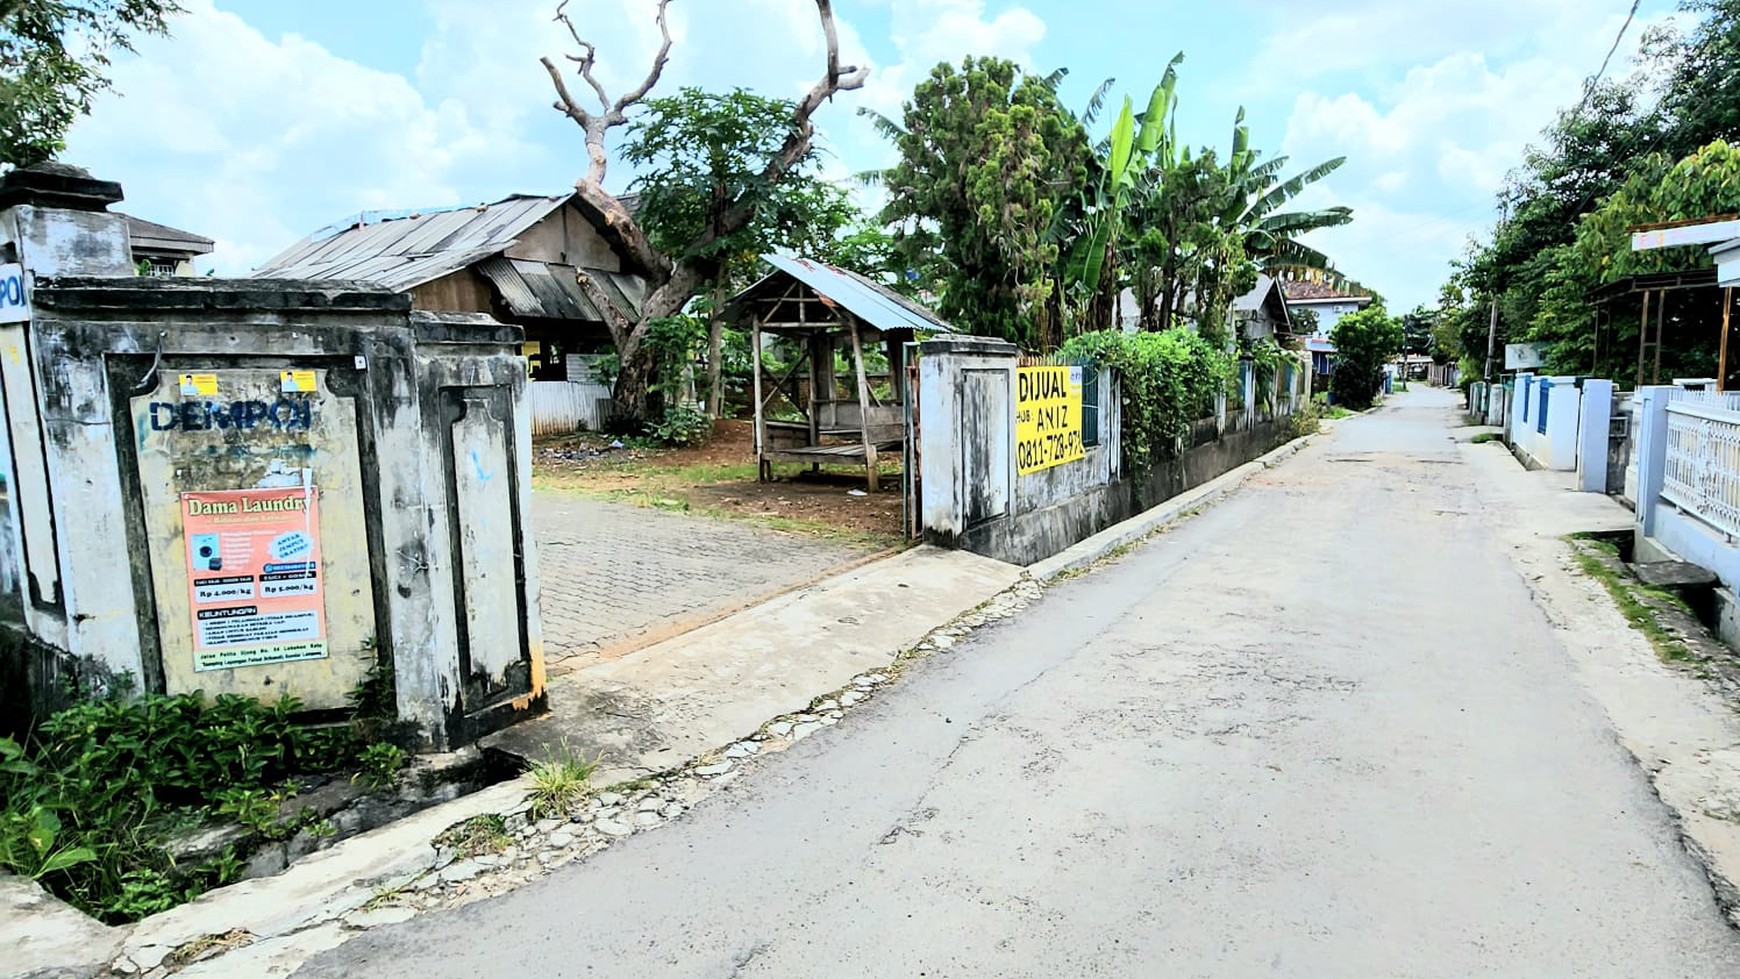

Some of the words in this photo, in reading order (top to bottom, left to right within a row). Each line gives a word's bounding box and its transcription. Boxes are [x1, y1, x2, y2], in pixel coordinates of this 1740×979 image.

[1018, 371, 1067, 402] DIJUAL
[1037, 405, 1068, 432] ANIZ
[188, 499, 238, 516] Dama
[242, 495, 309, 514] Laundry
[199, 608, 257, 618] KEUNTUNGAN
